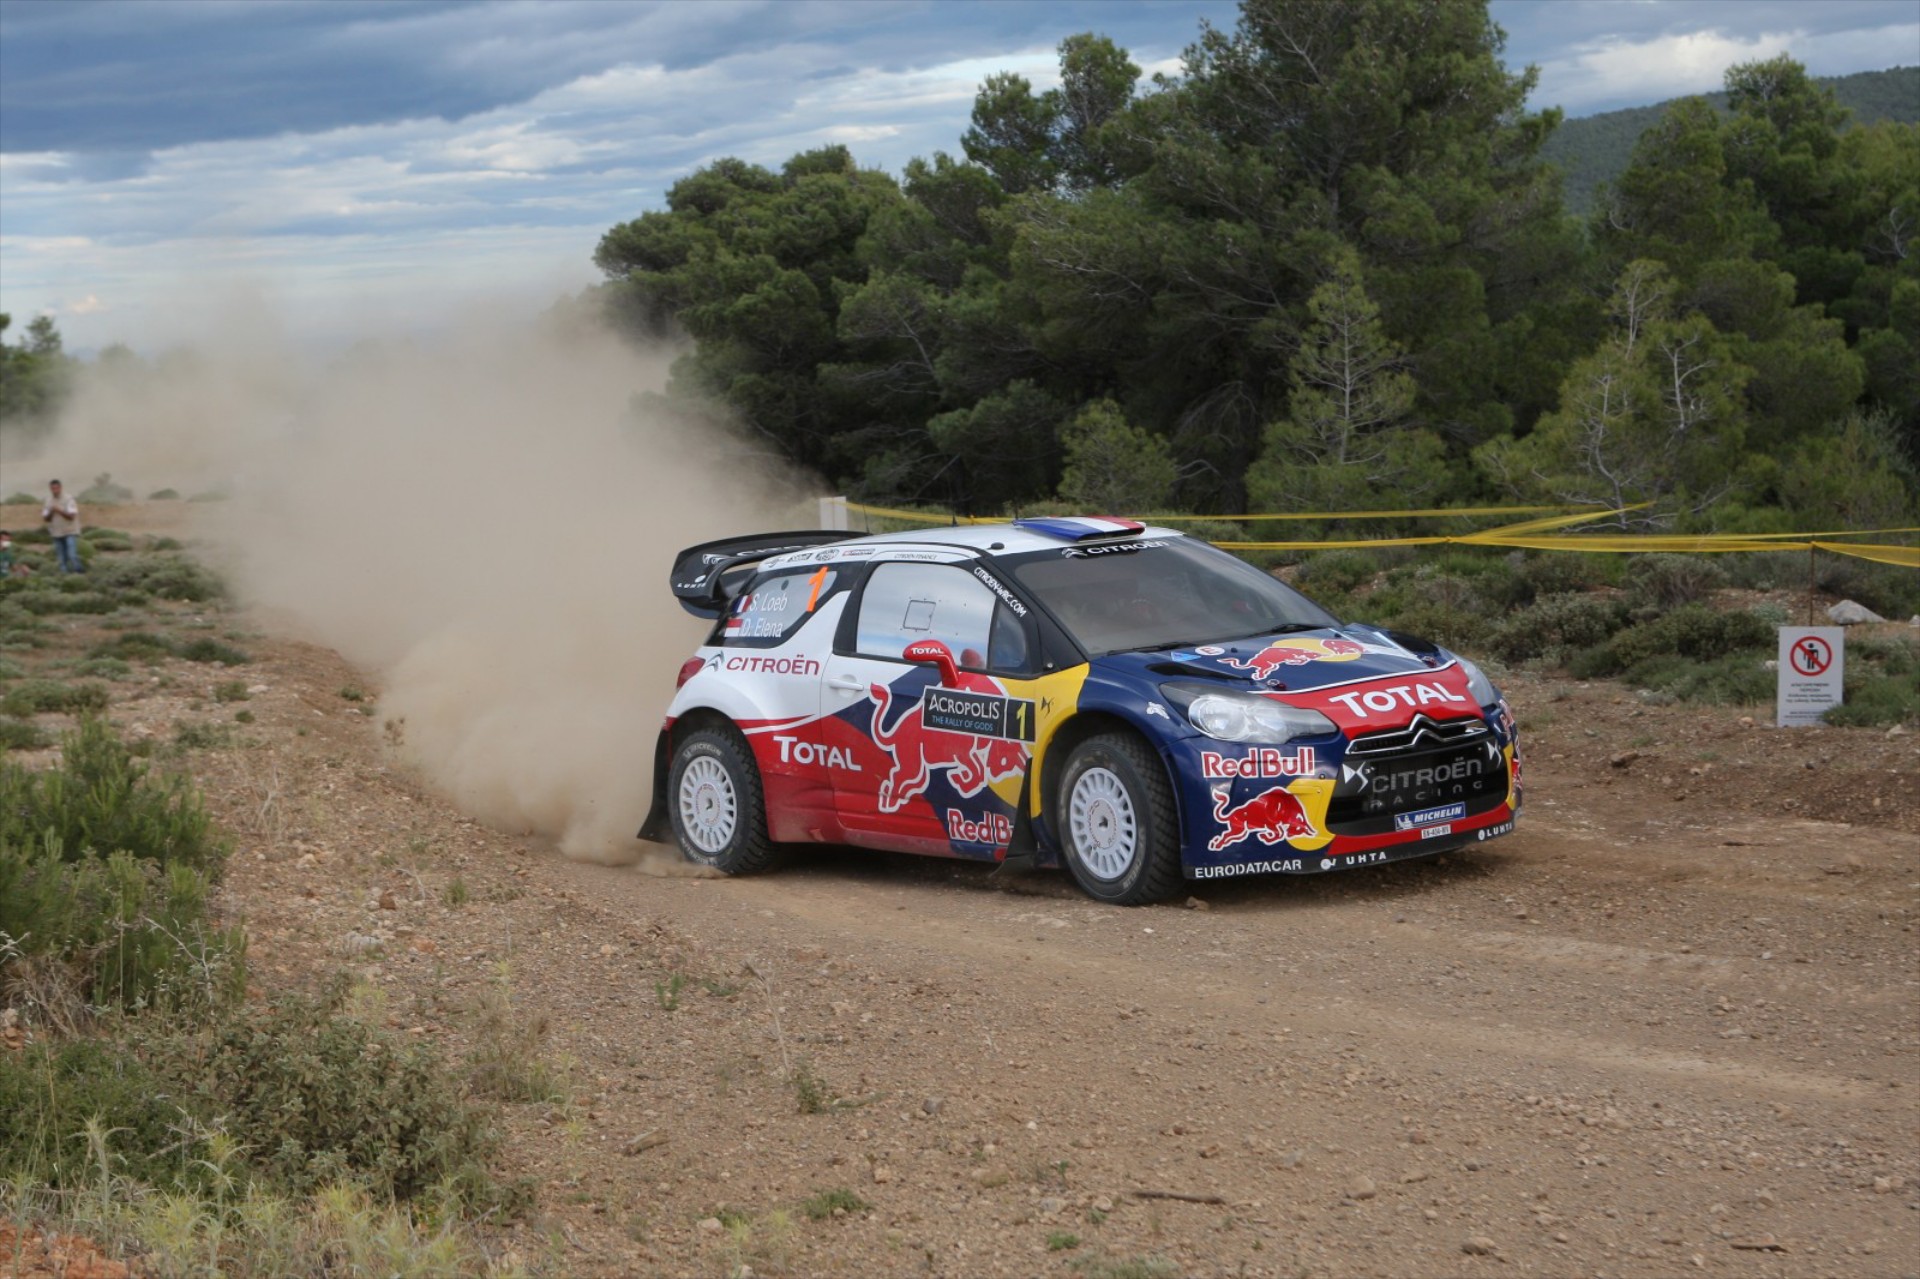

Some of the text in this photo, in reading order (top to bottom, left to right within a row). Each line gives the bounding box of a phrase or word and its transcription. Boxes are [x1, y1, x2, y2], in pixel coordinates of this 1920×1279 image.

[806, 566, 828, 612] 1
[761, 593, 788, 612] Loeb
[755, 618, 783, 638] Elena
[911, 647, 944, 655] TOTAL
[726, 654, 820, 676] CITROËN
[928, 694, 1000, 720] ACROPOLIS
[1329, 681, 1467, 719] TOTAL
[932, 715, 994, 732] THE RALLY OF GODS
[1016, 702, 1027, 740] 1
[773, 735, 862, 771] TOTAL
[1201, 746, 1315, 779] Red Bull
[1372, 756, 1483, 794] CITROËN
[947, 808, 995, 844] Red
[1413, 806, 1462, 823] MICHELIN
[1195, 859, 1302, 879] EURODATACAR
